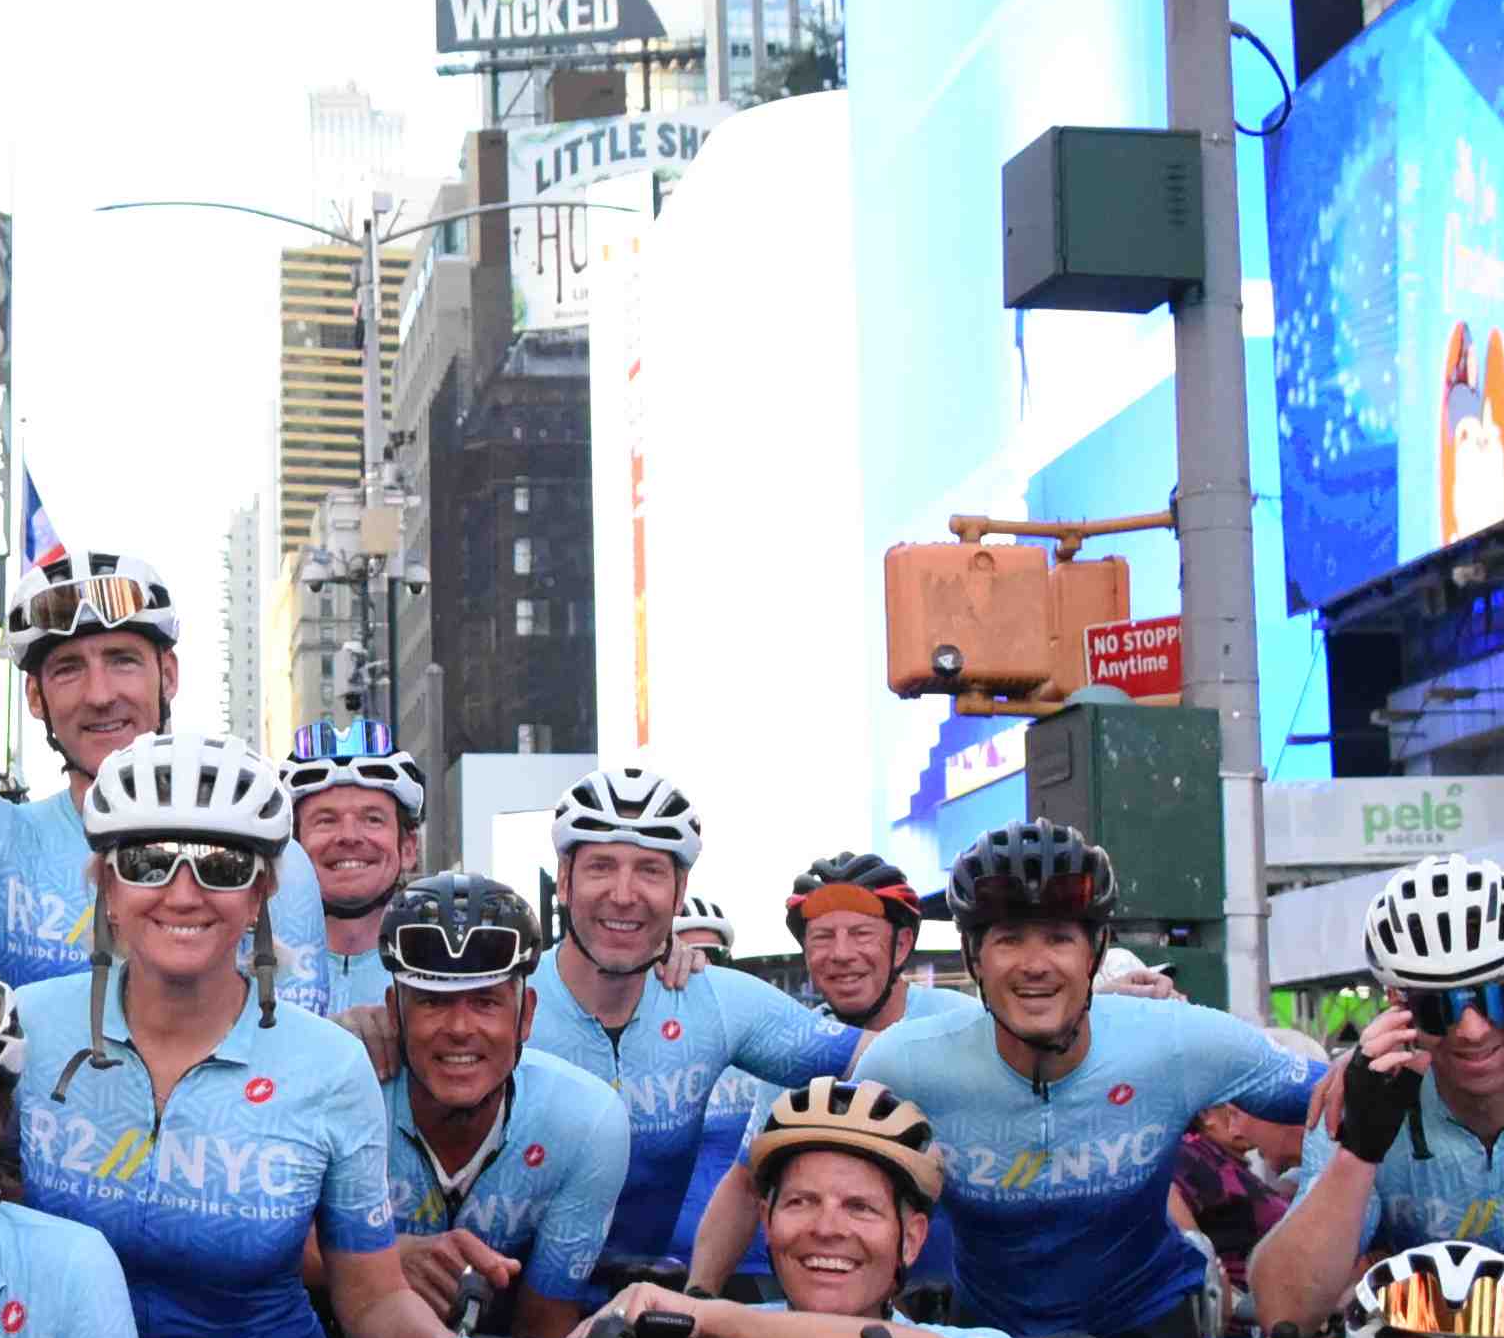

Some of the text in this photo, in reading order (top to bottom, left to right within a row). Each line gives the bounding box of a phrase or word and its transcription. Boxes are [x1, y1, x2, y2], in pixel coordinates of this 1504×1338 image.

[535, 120, 710, 196] LITTLE SH
[1093, 632, 1119, 655] NO
[1097, 654, 1169, 679] Anytime
[27, 1107, 306, 1198] R2//NYC
[86, 1182, 126, 1202] FOR
[134, 1187, 236, 1217] CAMPFIRE
[238, 1202, 298, 1222] CIRCLE
